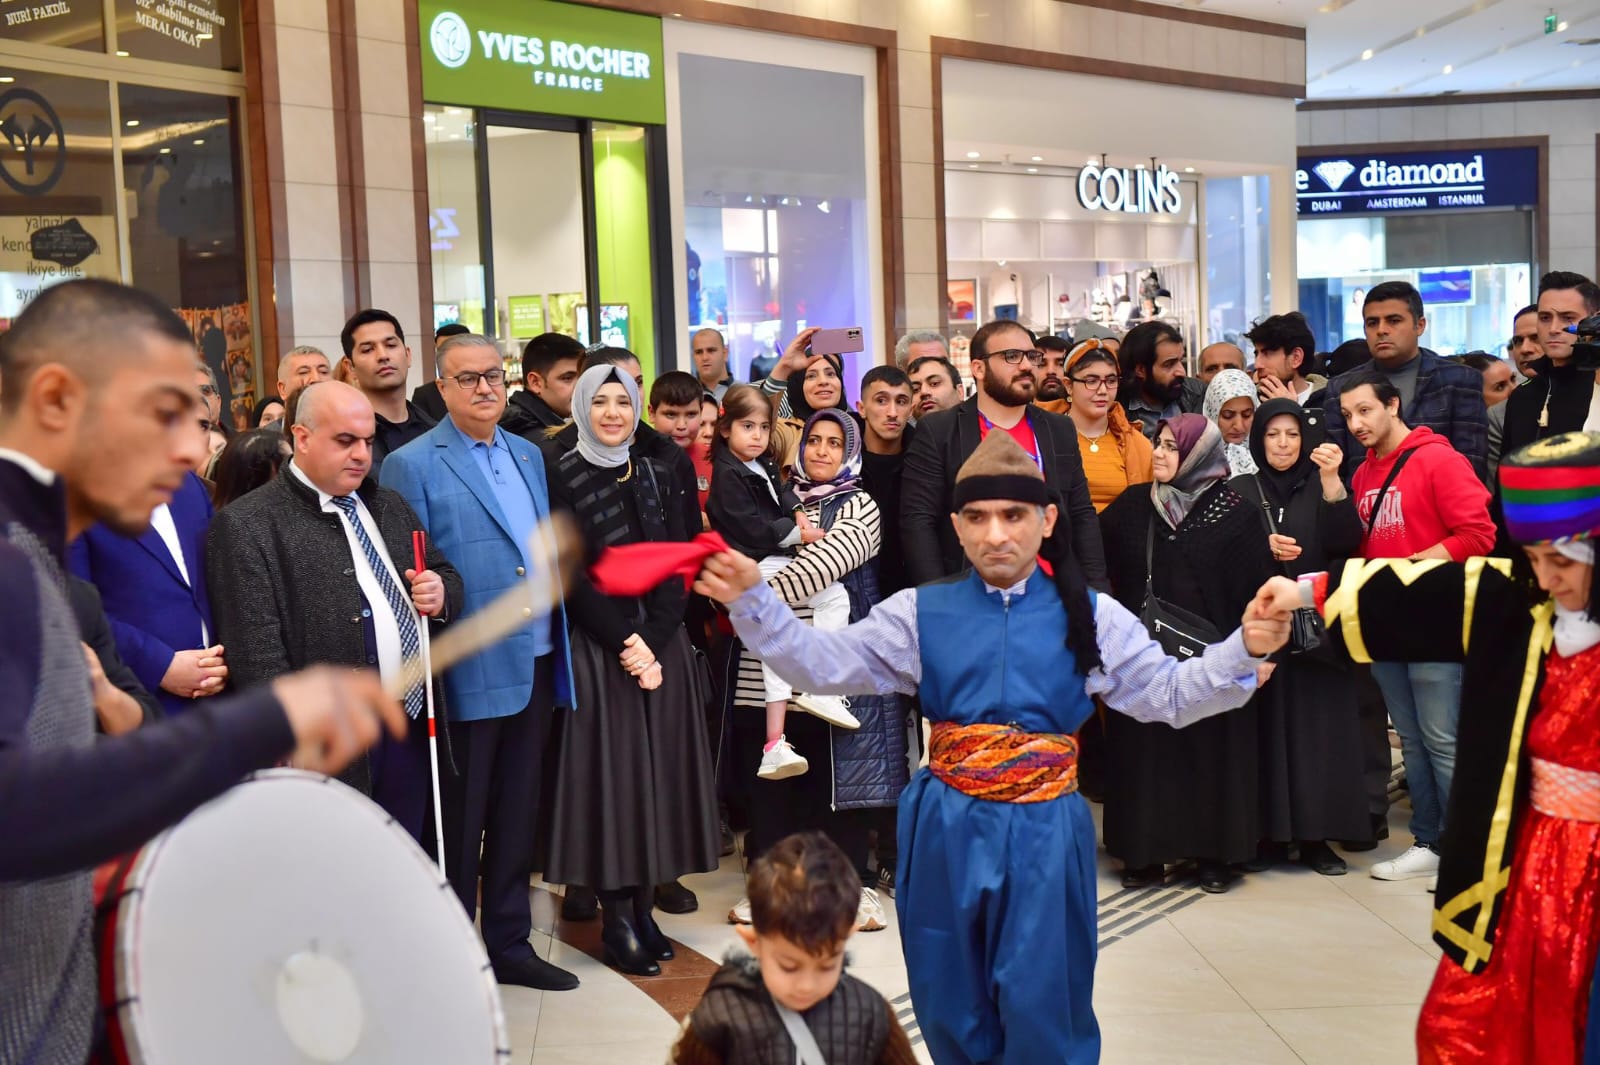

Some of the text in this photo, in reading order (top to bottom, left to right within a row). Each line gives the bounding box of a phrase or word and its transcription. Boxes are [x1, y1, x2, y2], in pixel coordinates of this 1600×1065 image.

[5, 0, 71, 26] NURİ PAKDİL
[156, 3, 195, 28] olabilme
[188, 2, 226, 26] ezmeden
[135, 11, 202, 48] MERAL OKAY
[477, 30, 651, 79] YVES ROCHER
[533, 71, 604, 92] FRANCE
[1359, 155, 1485, 188] diamond
[1077, 164, 1182, 214] COLIN'S
[1311, 200, 1342, 212] DUBAI
[1366, 196, 1428, 209] AMSTERDAM
[1438, 194, 1486, 207] ISTANBUL
[26, 262, 56, 280] ikiye
